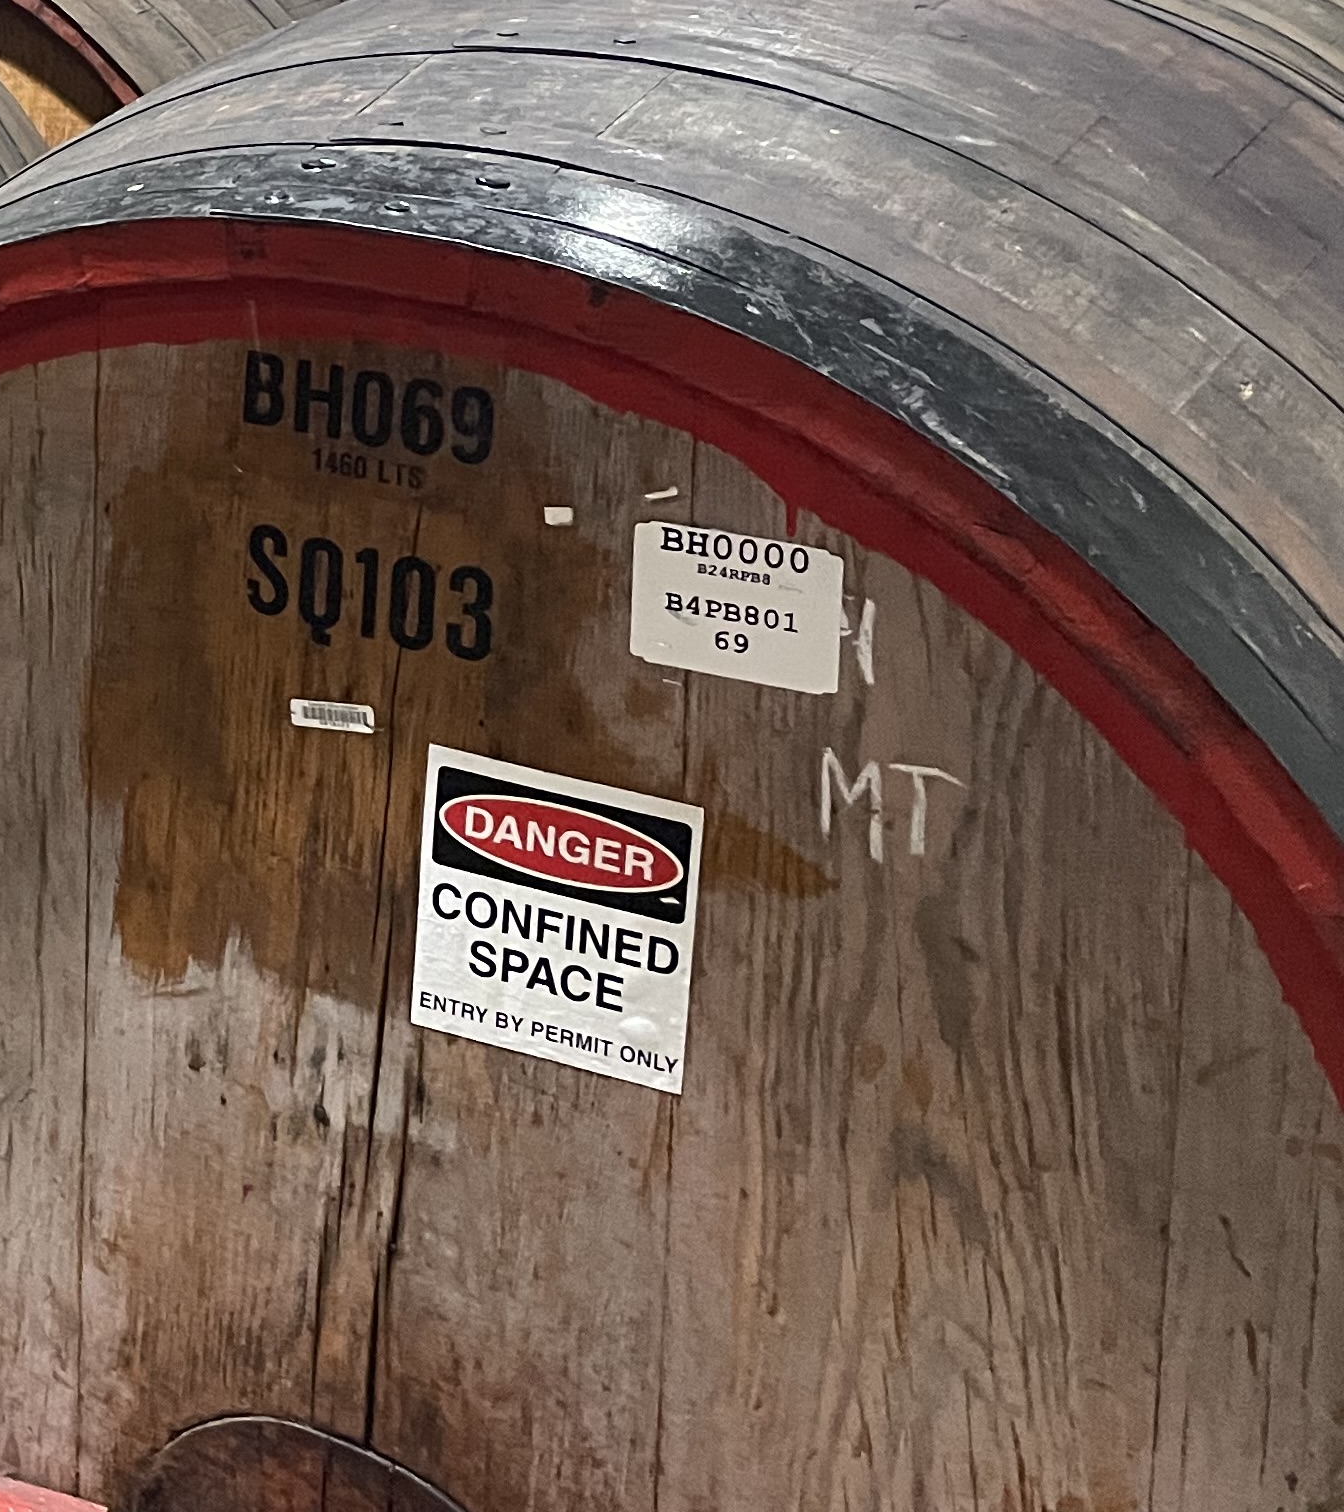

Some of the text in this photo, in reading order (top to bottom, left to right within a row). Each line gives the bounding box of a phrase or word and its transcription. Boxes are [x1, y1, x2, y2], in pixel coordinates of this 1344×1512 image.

[243, 350, 495, 466] BH069
[313, 448, 427, 488] 1460 LTS
[660, 526, 809, 573] BH0000
[697, 563, 771, 586] B24RPB8
[247, 524, 495, 661] SQ103
[665, 592, 799, 633] B4PB801
[714, 631, 749, 654] 69
[820, 747, 968, 864] MT
[464, 805, 655, 882] DANGER
[432, 883, 680, 975] CONFINED
[468, 940, 624, 1013] SPACE
[419, 991, 678, 1074] ENTRY BY PERMIT ONLY
